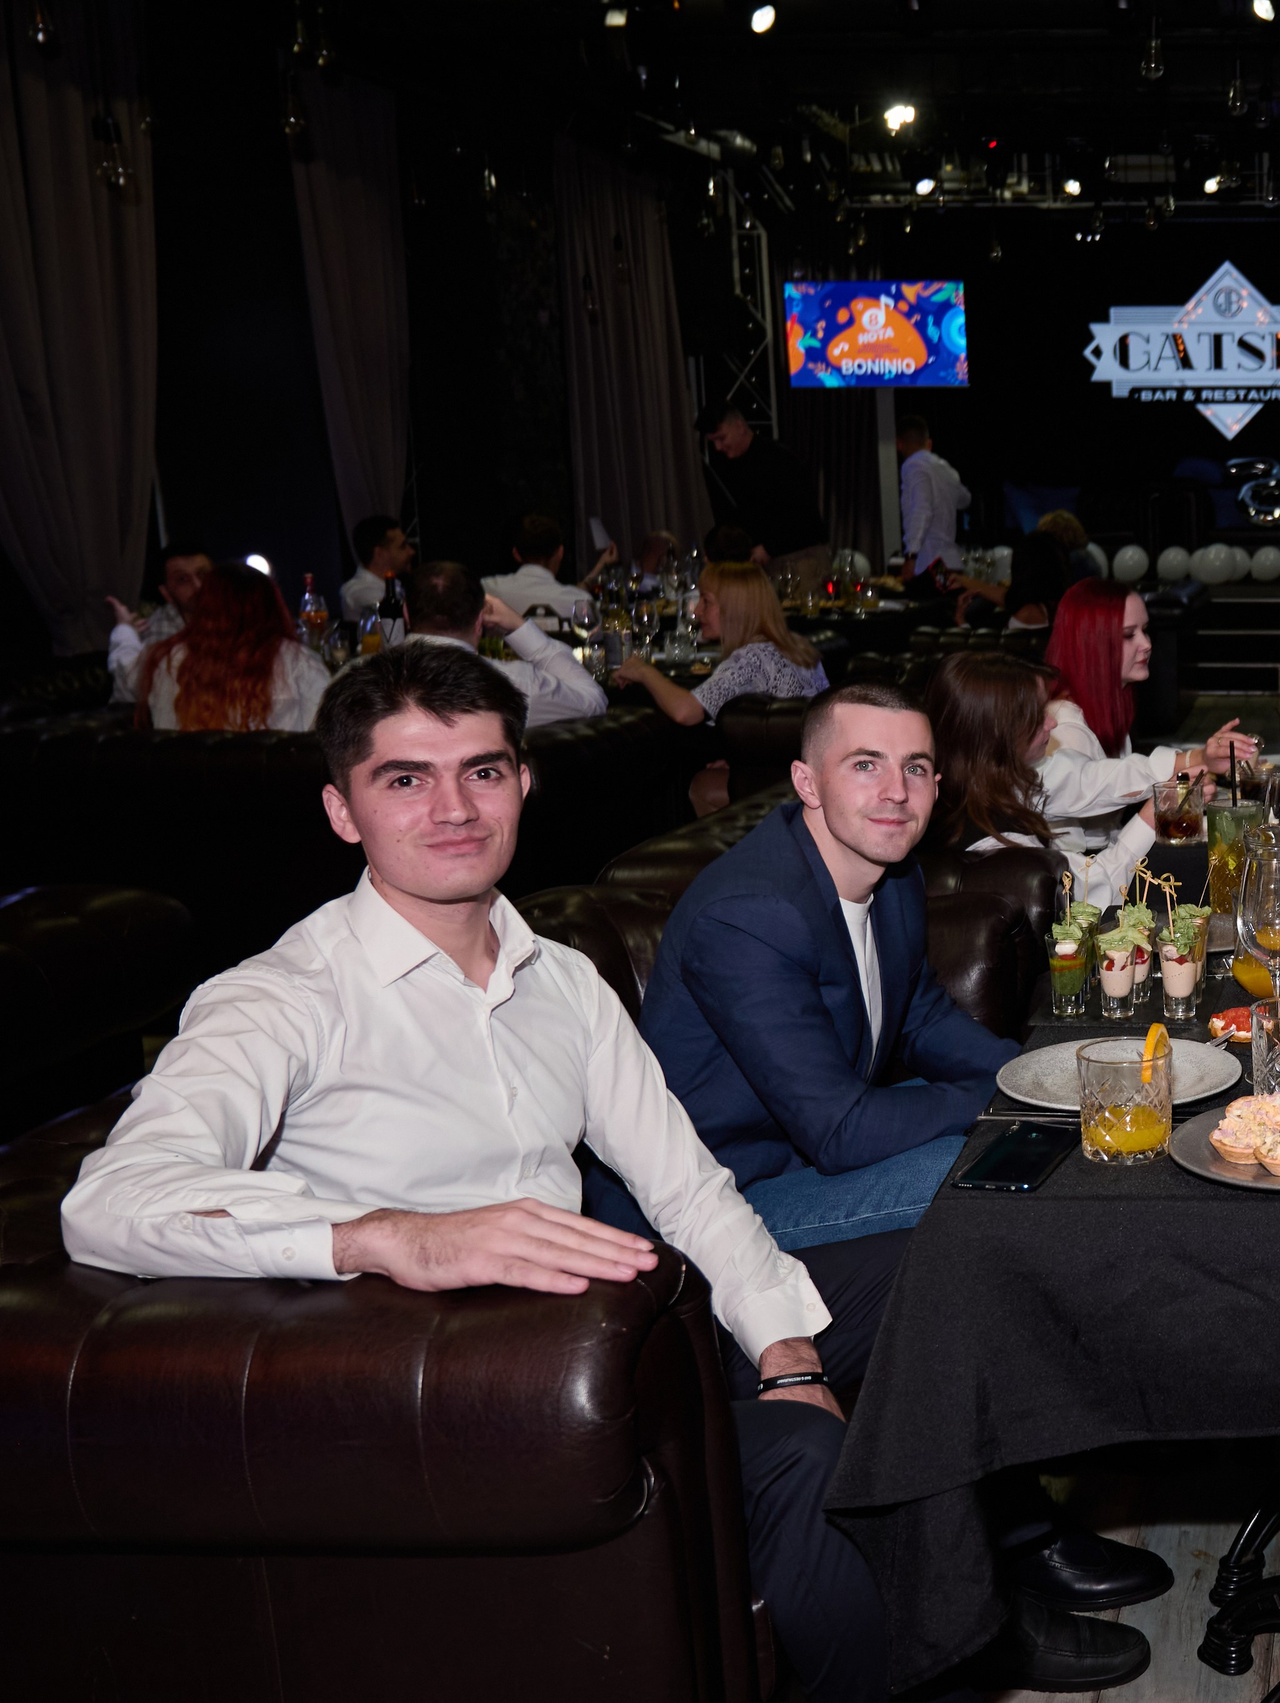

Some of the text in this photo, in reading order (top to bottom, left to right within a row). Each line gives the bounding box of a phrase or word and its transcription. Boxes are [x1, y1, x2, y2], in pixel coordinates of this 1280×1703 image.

[841, 357, 915, 375] BONINIO
[1140, 389, 1177, 402] BAR
[1183, 389, 1196, 401] &
